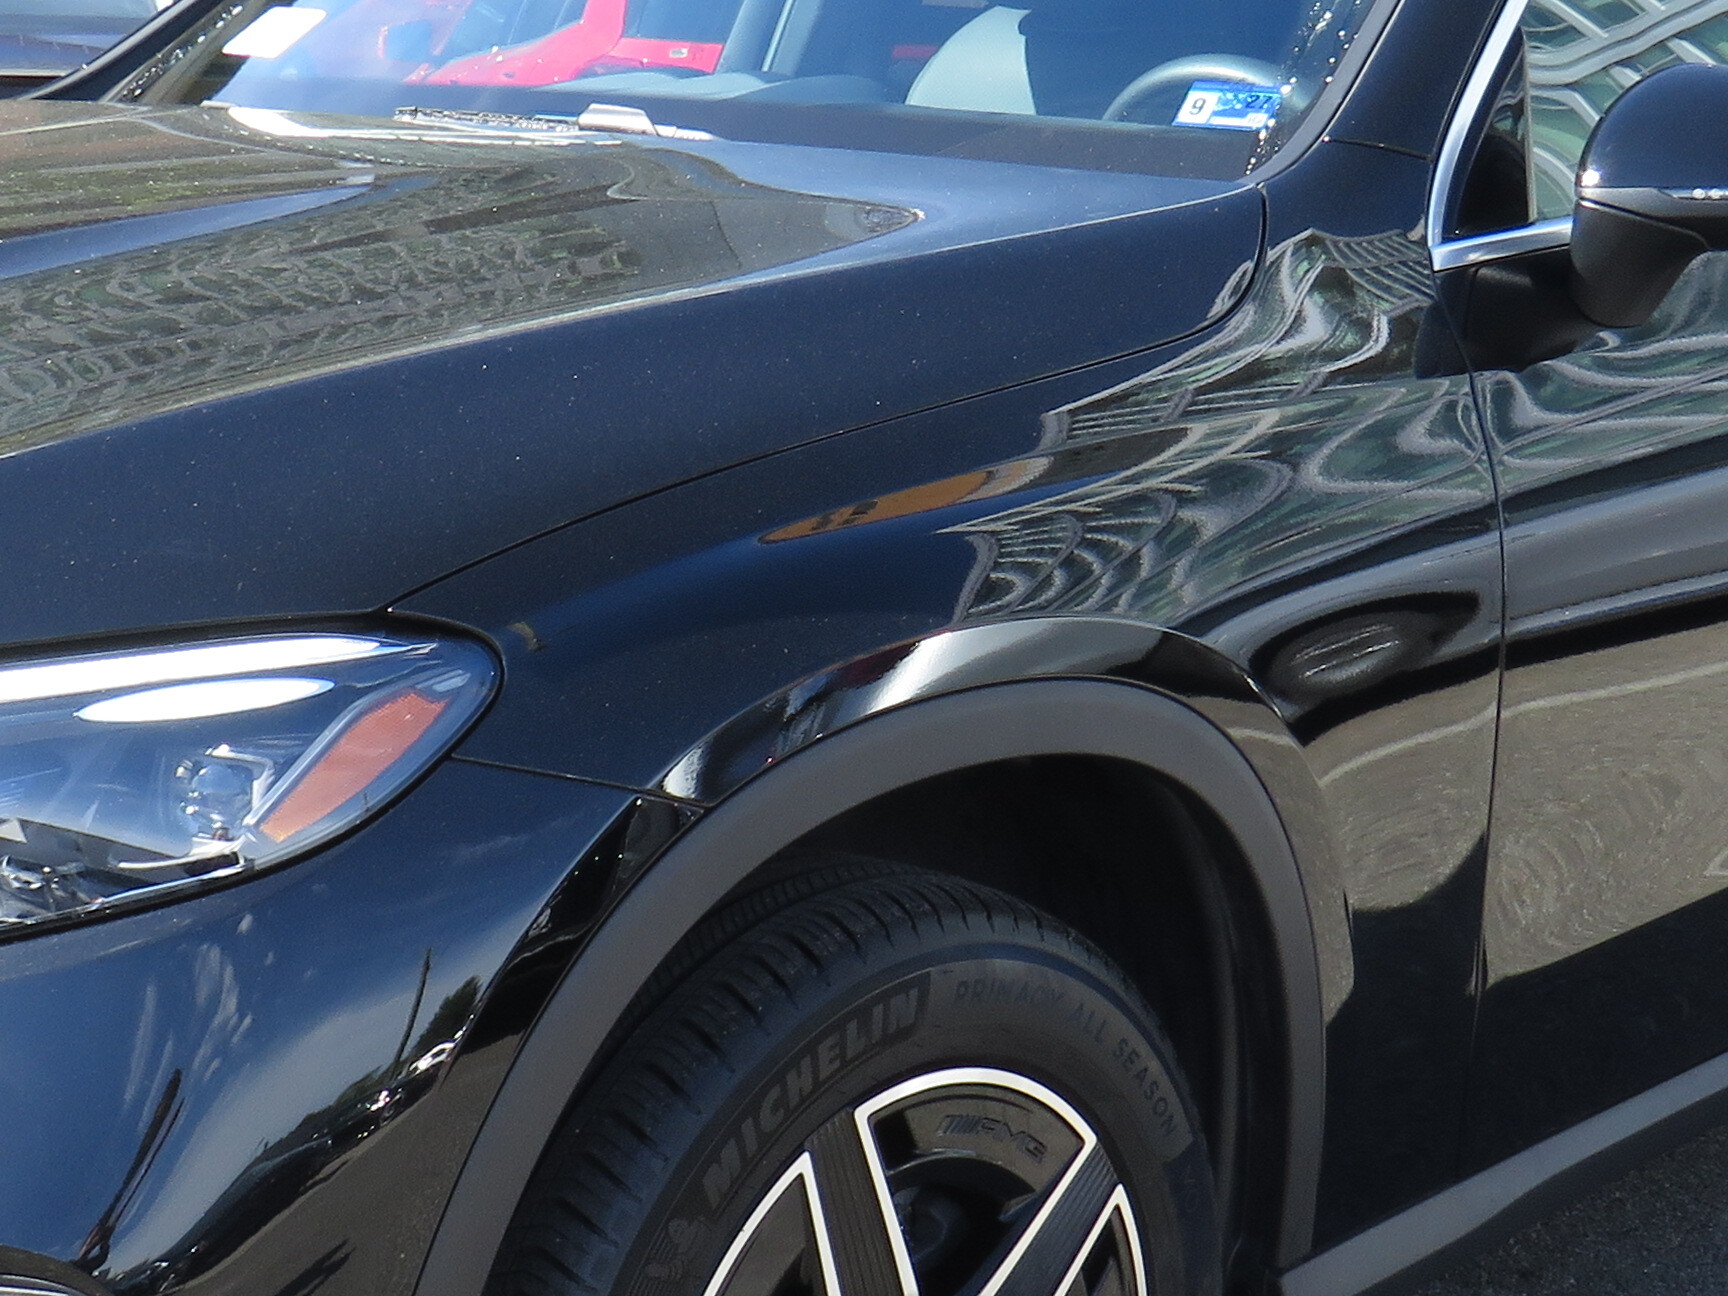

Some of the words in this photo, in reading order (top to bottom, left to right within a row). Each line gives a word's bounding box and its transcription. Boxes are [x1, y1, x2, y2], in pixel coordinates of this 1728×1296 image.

[1189, 97, 1207, 116] 9
[701, 986, 920, 1210] MICHELIN
[1112, 1037, 1177, 1138] SEASON
